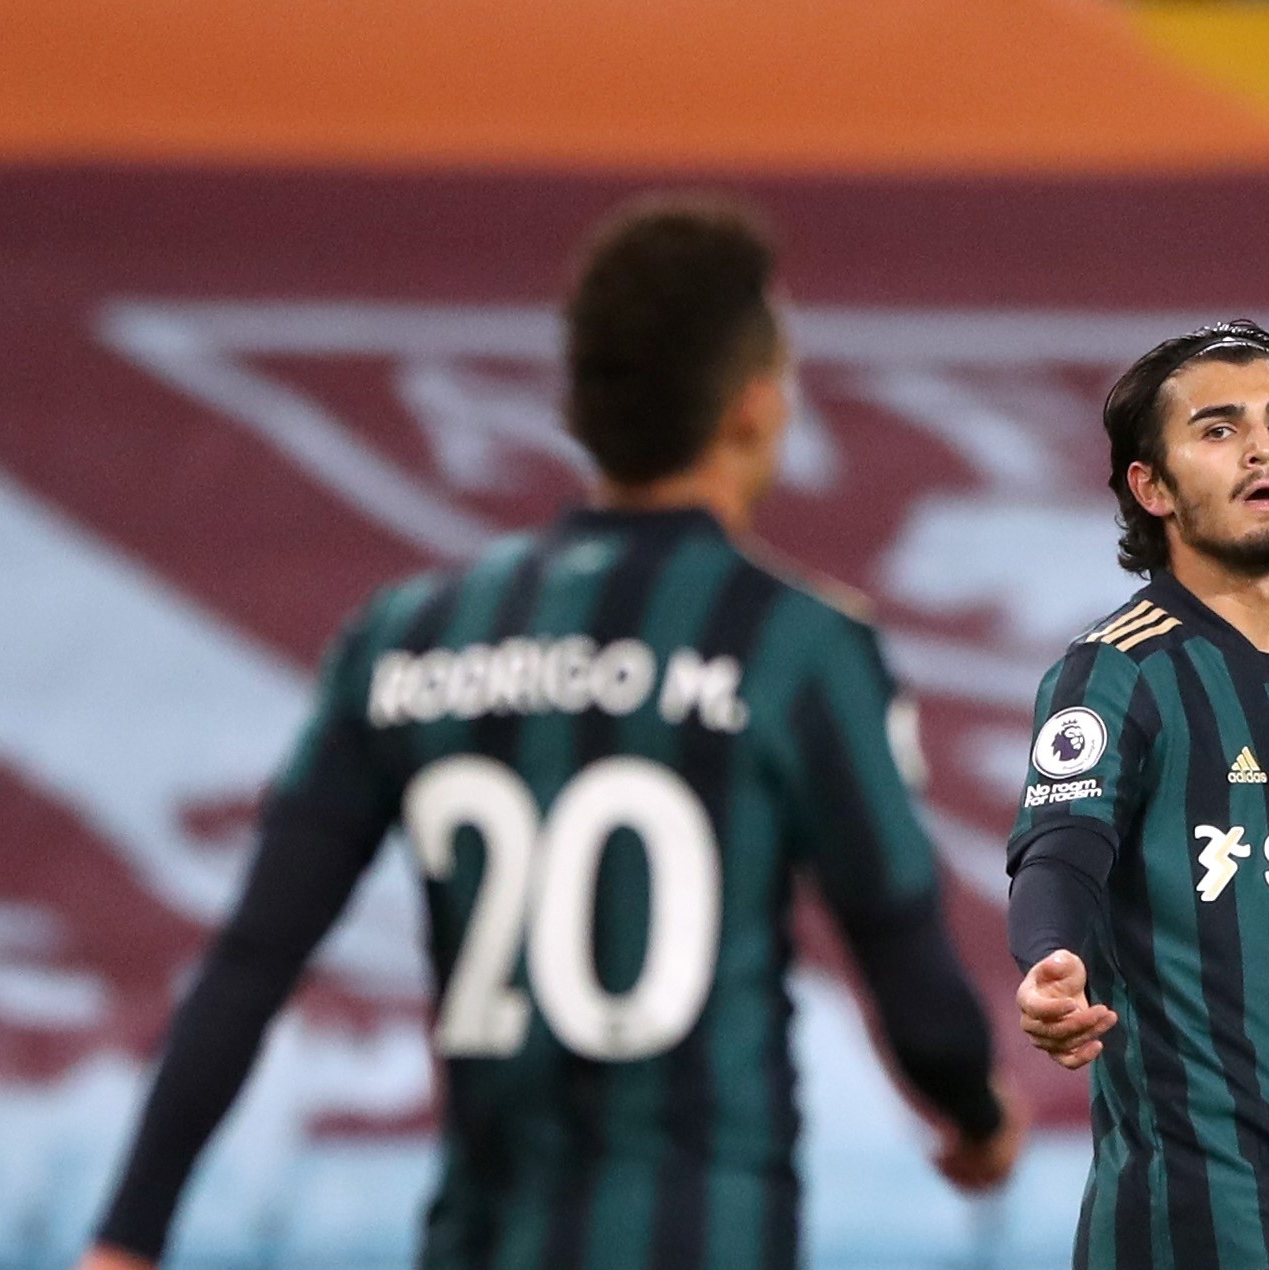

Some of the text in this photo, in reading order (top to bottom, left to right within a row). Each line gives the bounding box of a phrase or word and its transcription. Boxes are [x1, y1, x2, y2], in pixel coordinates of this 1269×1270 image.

[368, 633, 658, 729] RODRIGO
[1027, 779, 1097, 797] No room
[1227, 770, 1268, 784] adidas
[403, 752, 723, 1062] 20
